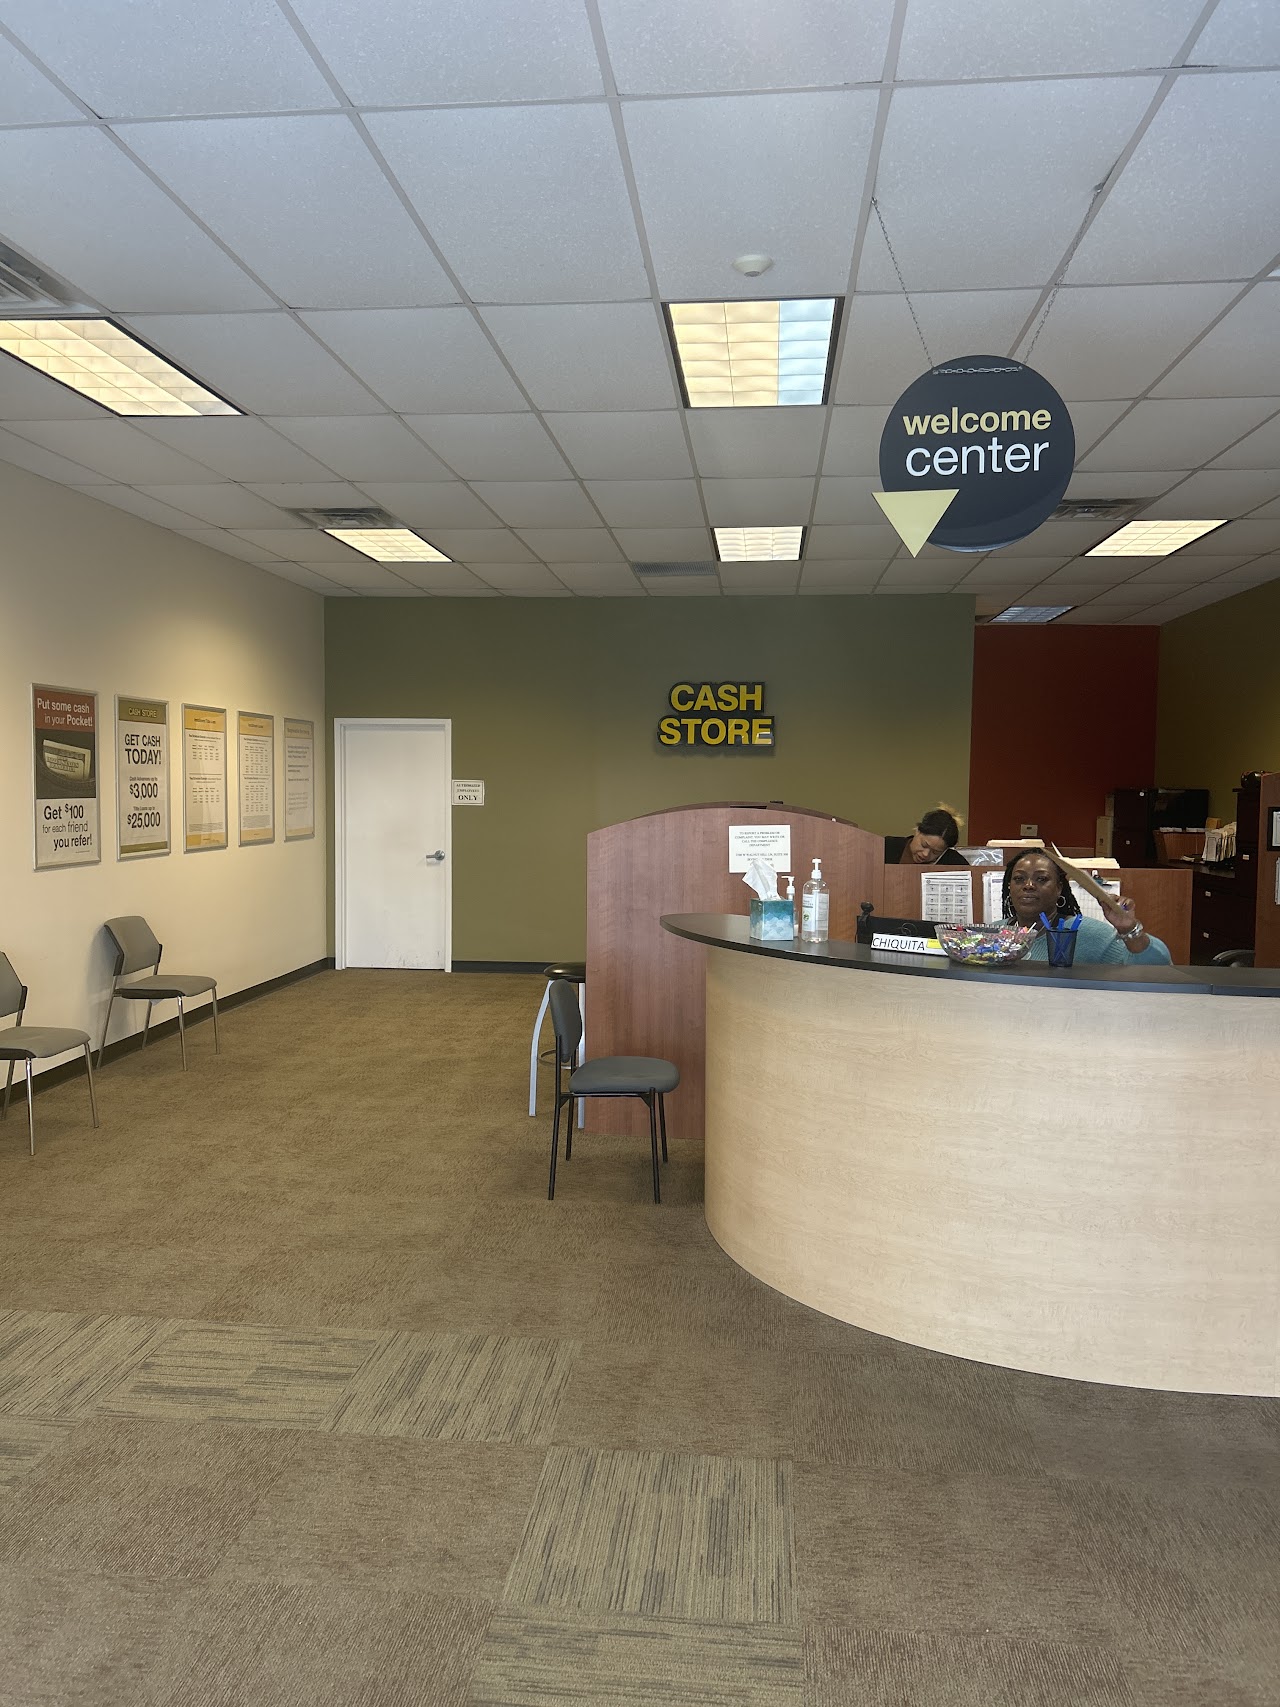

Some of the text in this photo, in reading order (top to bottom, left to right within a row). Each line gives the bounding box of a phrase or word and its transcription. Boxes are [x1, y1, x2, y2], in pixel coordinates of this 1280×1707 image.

[903, 407, 1052, 436] welcome
[905, 437, 1050, 477] center
[37, 698, 90, 713] Put some cash
[670, 684, 763, 711] CASH
[44, 713, 93, 727] in your Pocket!
[129, 706, 157, 718] CASH STORE
[125, 733, 161, 747] GET CASH
[660, 718, 772, 745] STORE
[125, 748, 162, 765] TODAY!
[129, 782, 159, 800] $3,000
[43, 803, 84, 820] Get $100
[42, 820, 88, 834] for each friend
[127, 811, 161, 830] $25,000
[53, 833, 93, 851] you refer!
[872, 937, 925, 951] CHIQUITA
